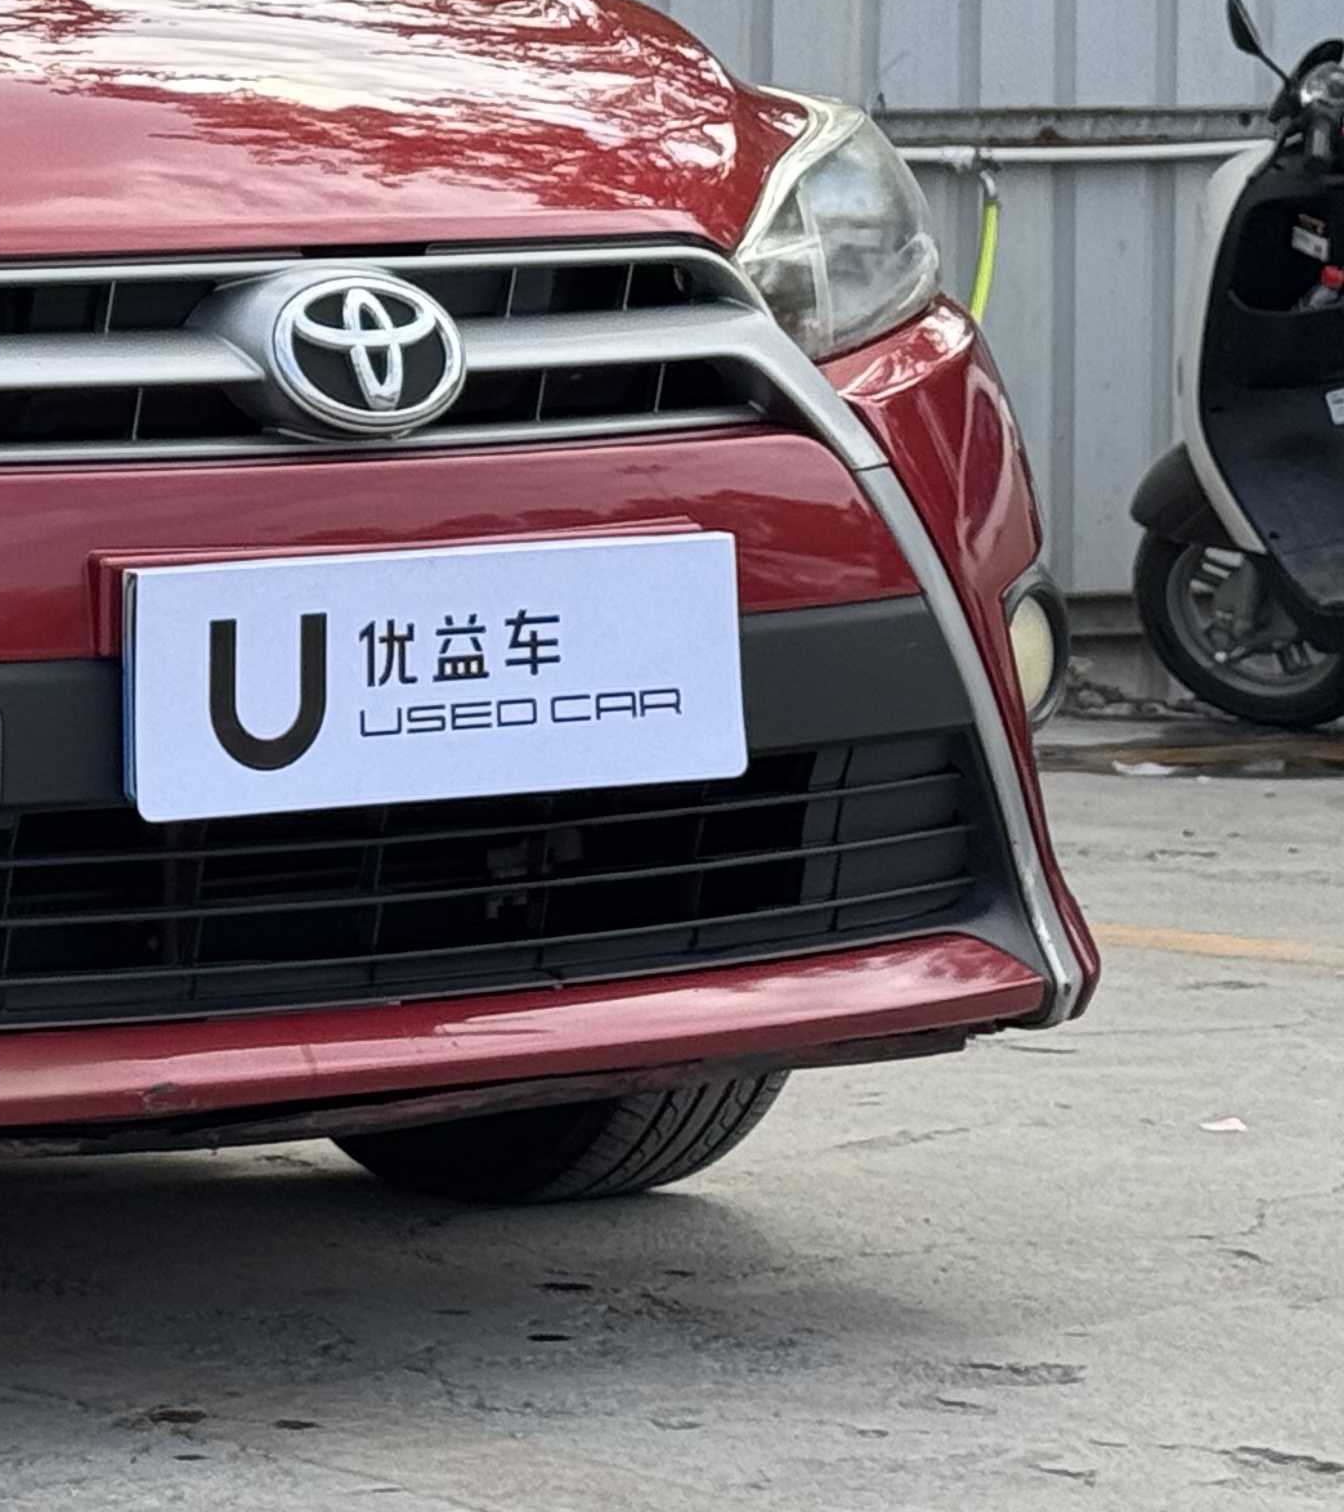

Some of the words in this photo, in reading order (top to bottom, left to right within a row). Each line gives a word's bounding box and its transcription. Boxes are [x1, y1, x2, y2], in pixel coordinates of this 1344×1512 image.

[358, 609, 562, 687] 优益车
[209, 612, 328, 772] U
[359, 697, 538, 737] USED
[550, 687, 683, 722] CAR
